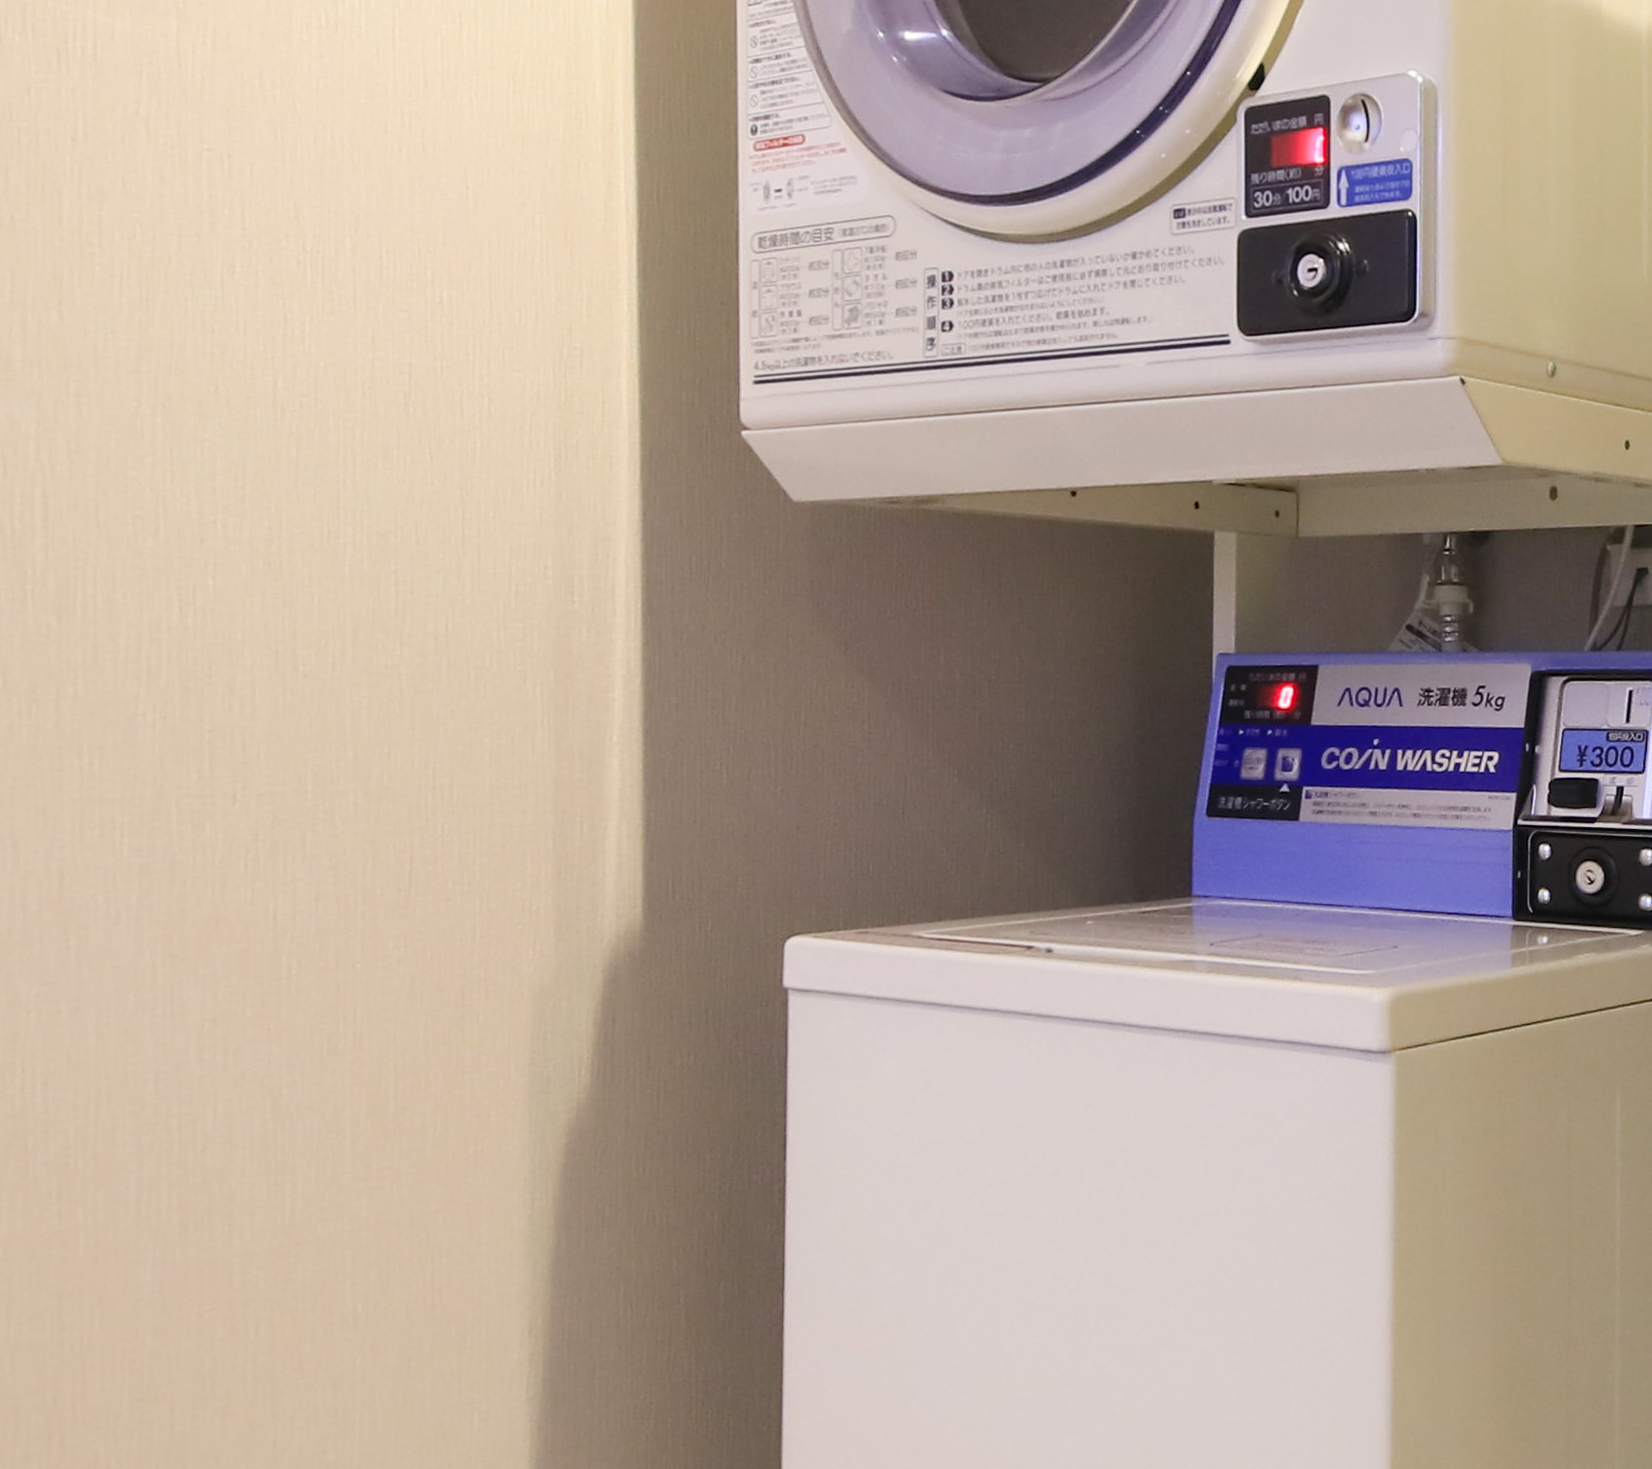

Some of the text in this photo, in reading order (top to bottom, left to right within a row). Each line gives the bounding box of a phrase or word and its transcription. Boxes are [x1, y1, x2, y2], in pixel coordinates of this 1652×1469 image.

[1277, 685, 1295, 710] 0
[1337, 685, 1506, 712] AQUA 洗濯機 5kg
[1321, 738, 1500, 774] COIN WASHER
[1576, 744, 1636, 769] ¥300
